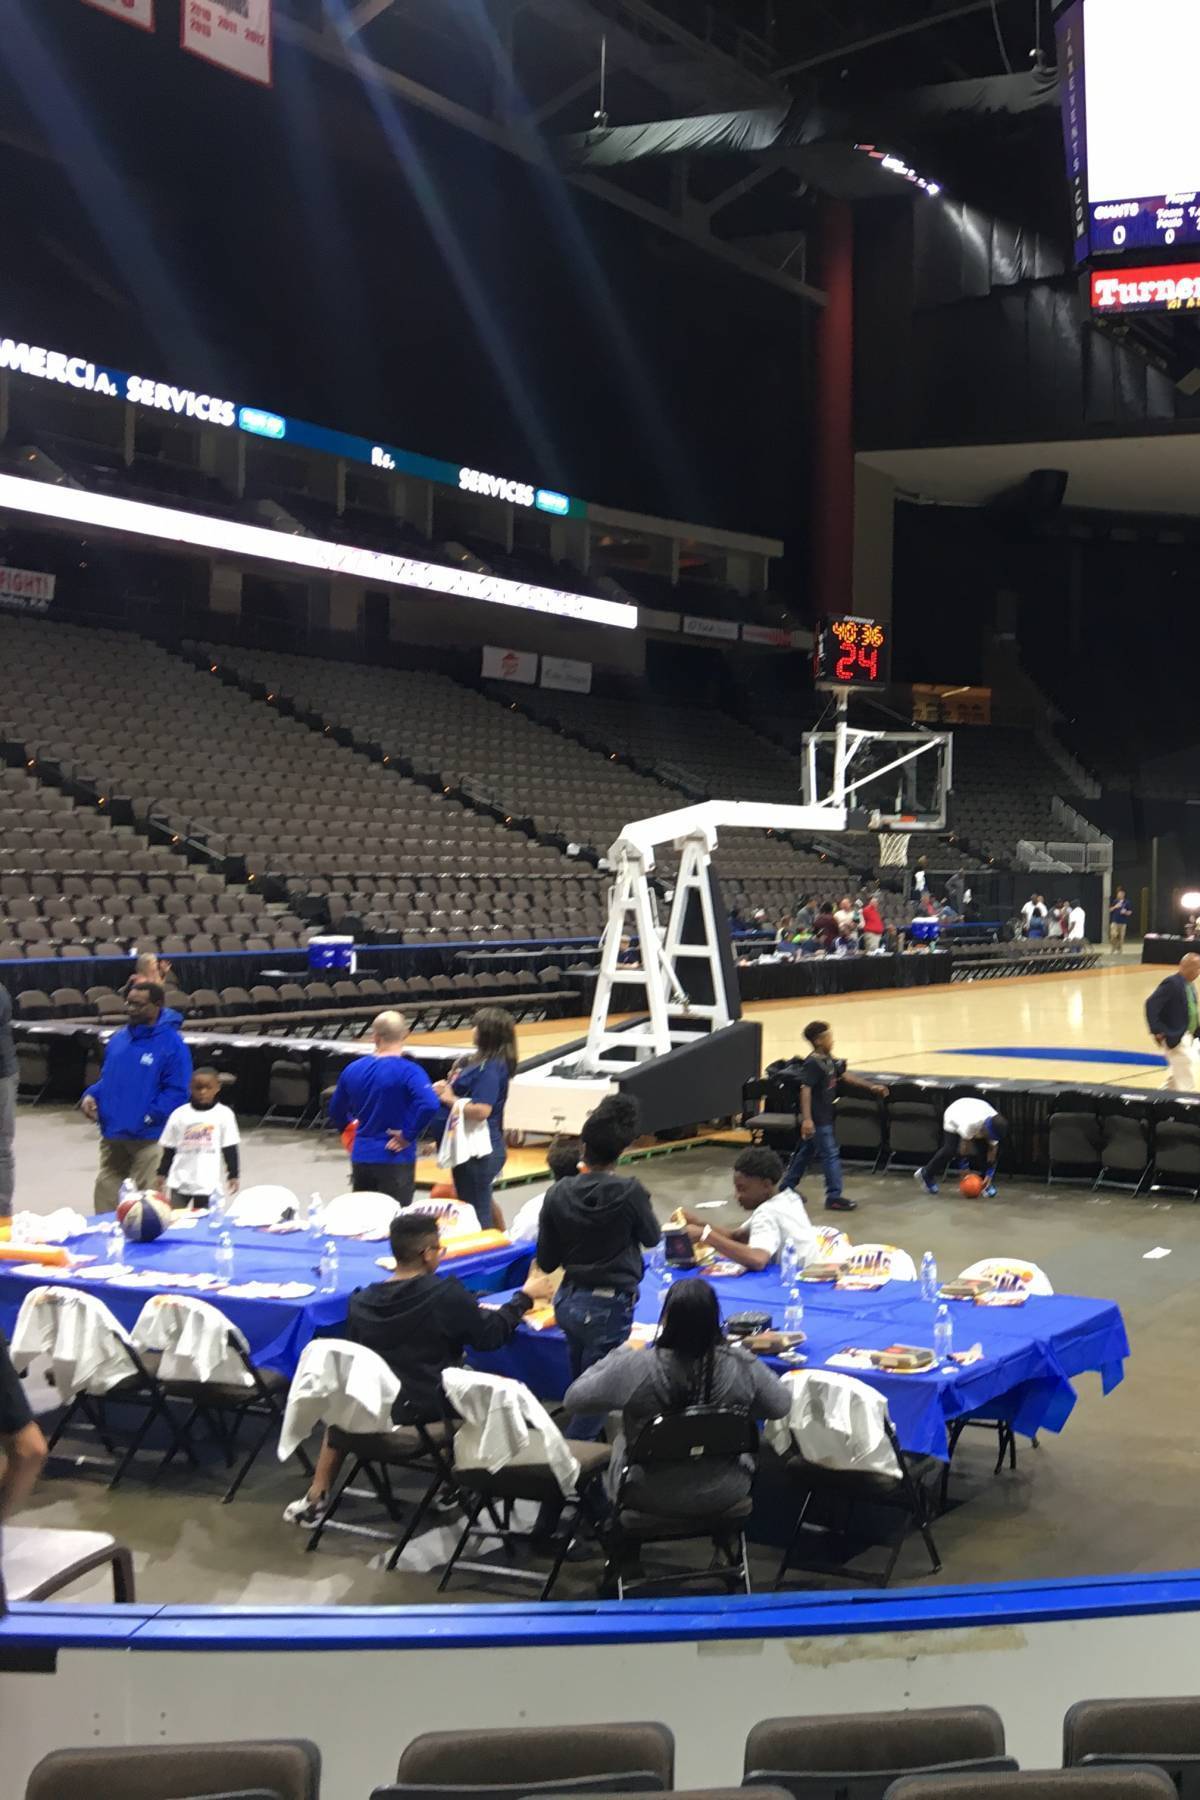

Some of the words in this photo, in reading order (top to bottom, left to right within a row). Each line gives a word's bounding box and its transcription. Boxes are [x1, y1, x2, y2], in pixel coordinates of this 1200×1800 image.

[1112, 225, 1126, 245] 0
[1164, 228, 1175, 245] 0
[126, 375, 236, 427] SERVICES
[458, 467, 535, 507] SERVICES
[832, 621, 884, 647] 40:36
[836, 640, 878, 680] 24
